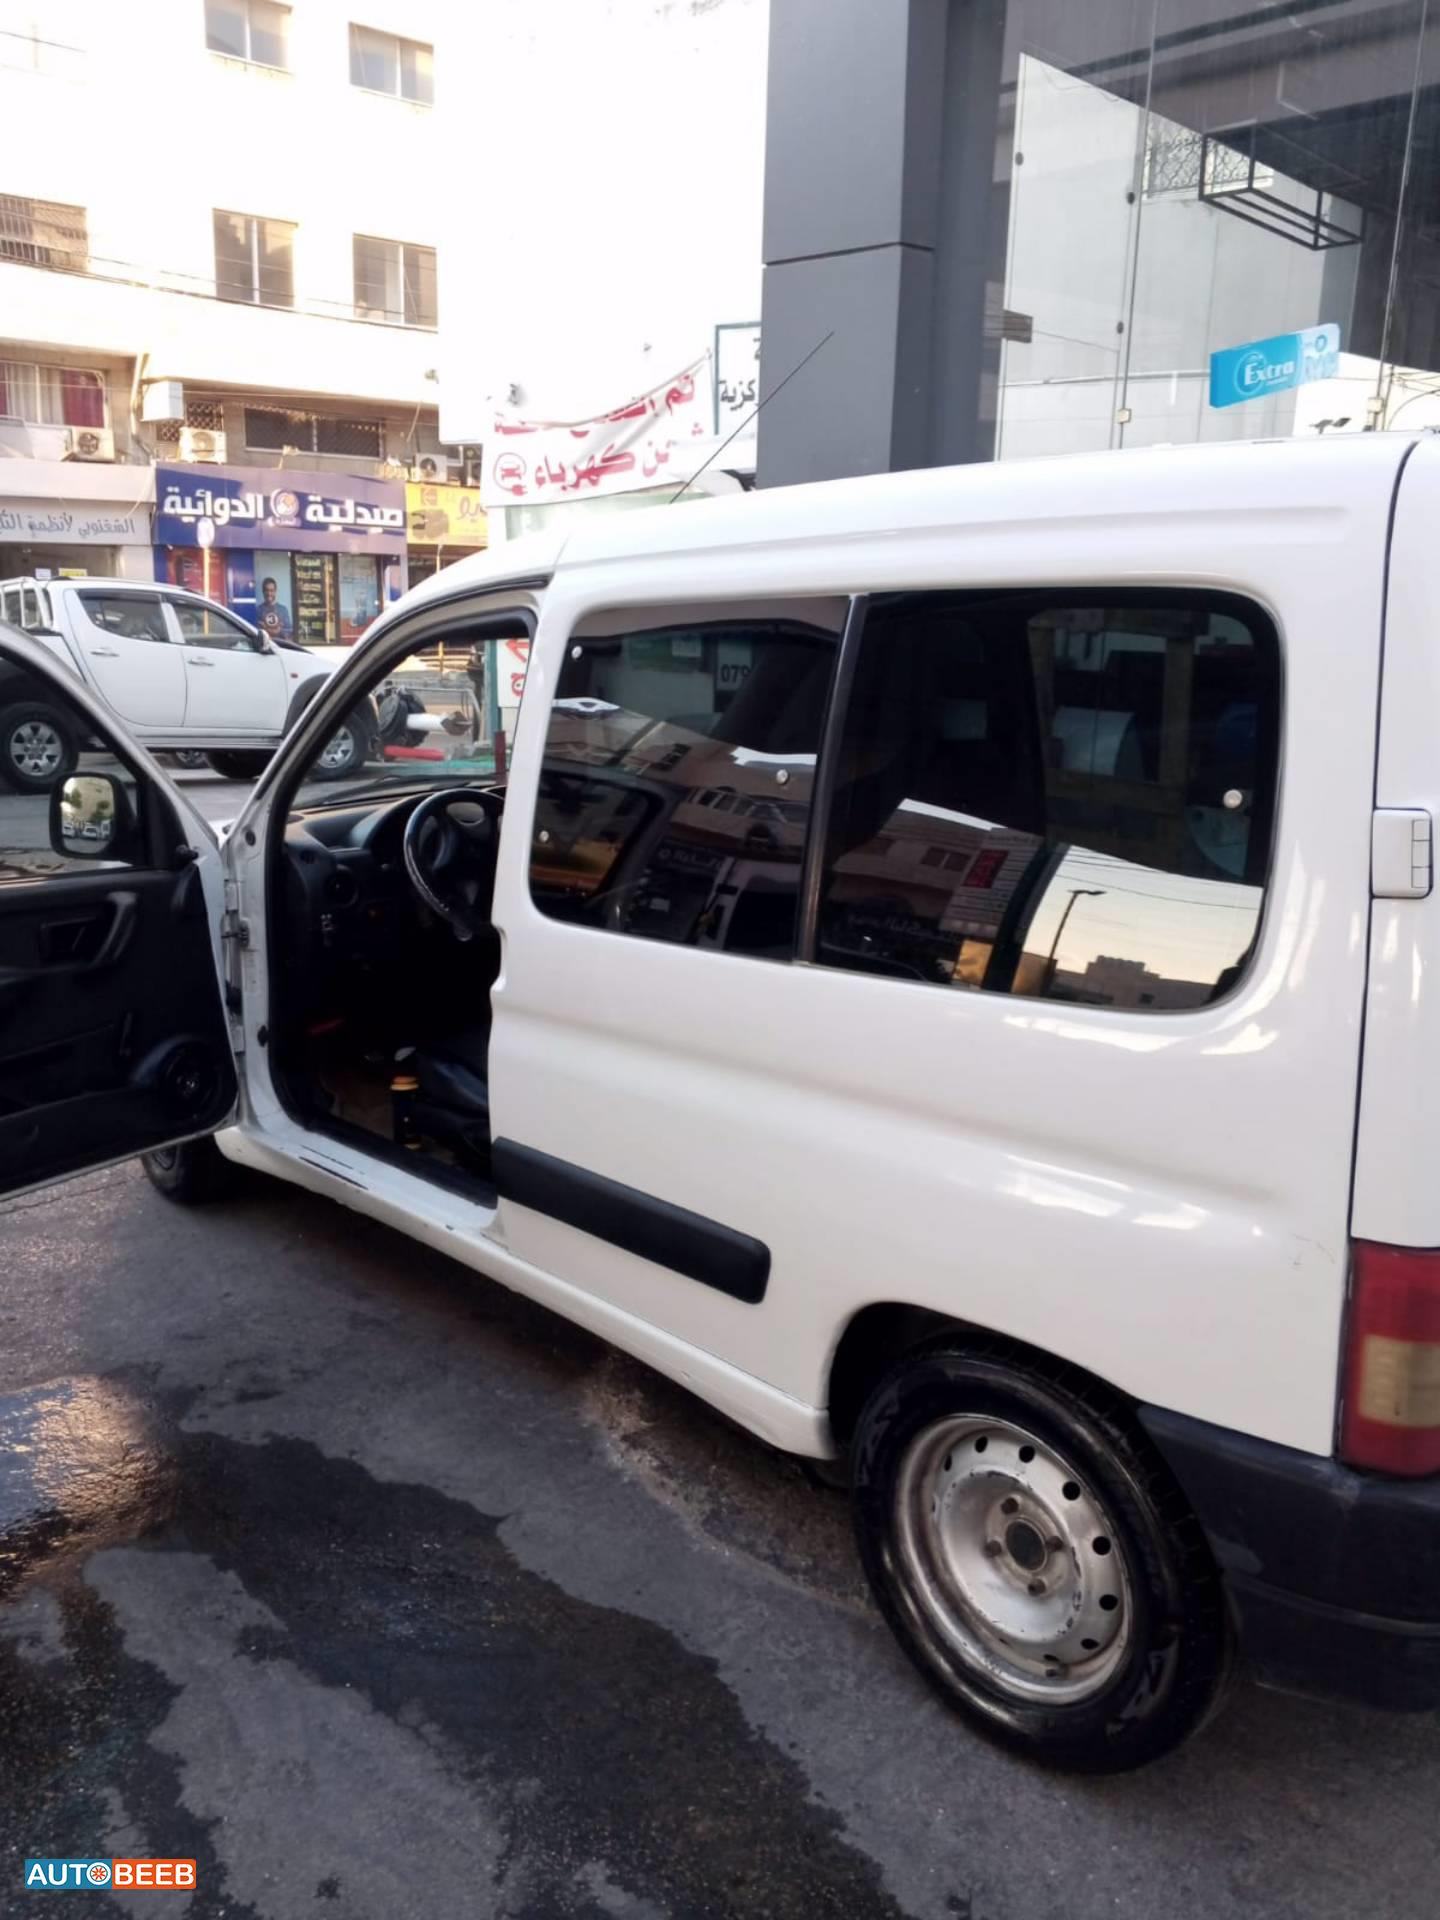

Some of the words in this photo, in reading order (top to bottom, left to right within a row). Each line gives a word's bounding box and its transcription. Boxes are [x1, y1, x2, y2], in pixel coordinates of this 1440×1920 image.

[1244, 361, 1295, 385] Extra
[719, 379, 759, 412] كزية
[534, 443, 636, 491] كهرباء
[27, 511, 73, 533] لأنظمة
[163, 486, 264, 526] الدوائية
[305, 494, 404, 534] صيدلية
